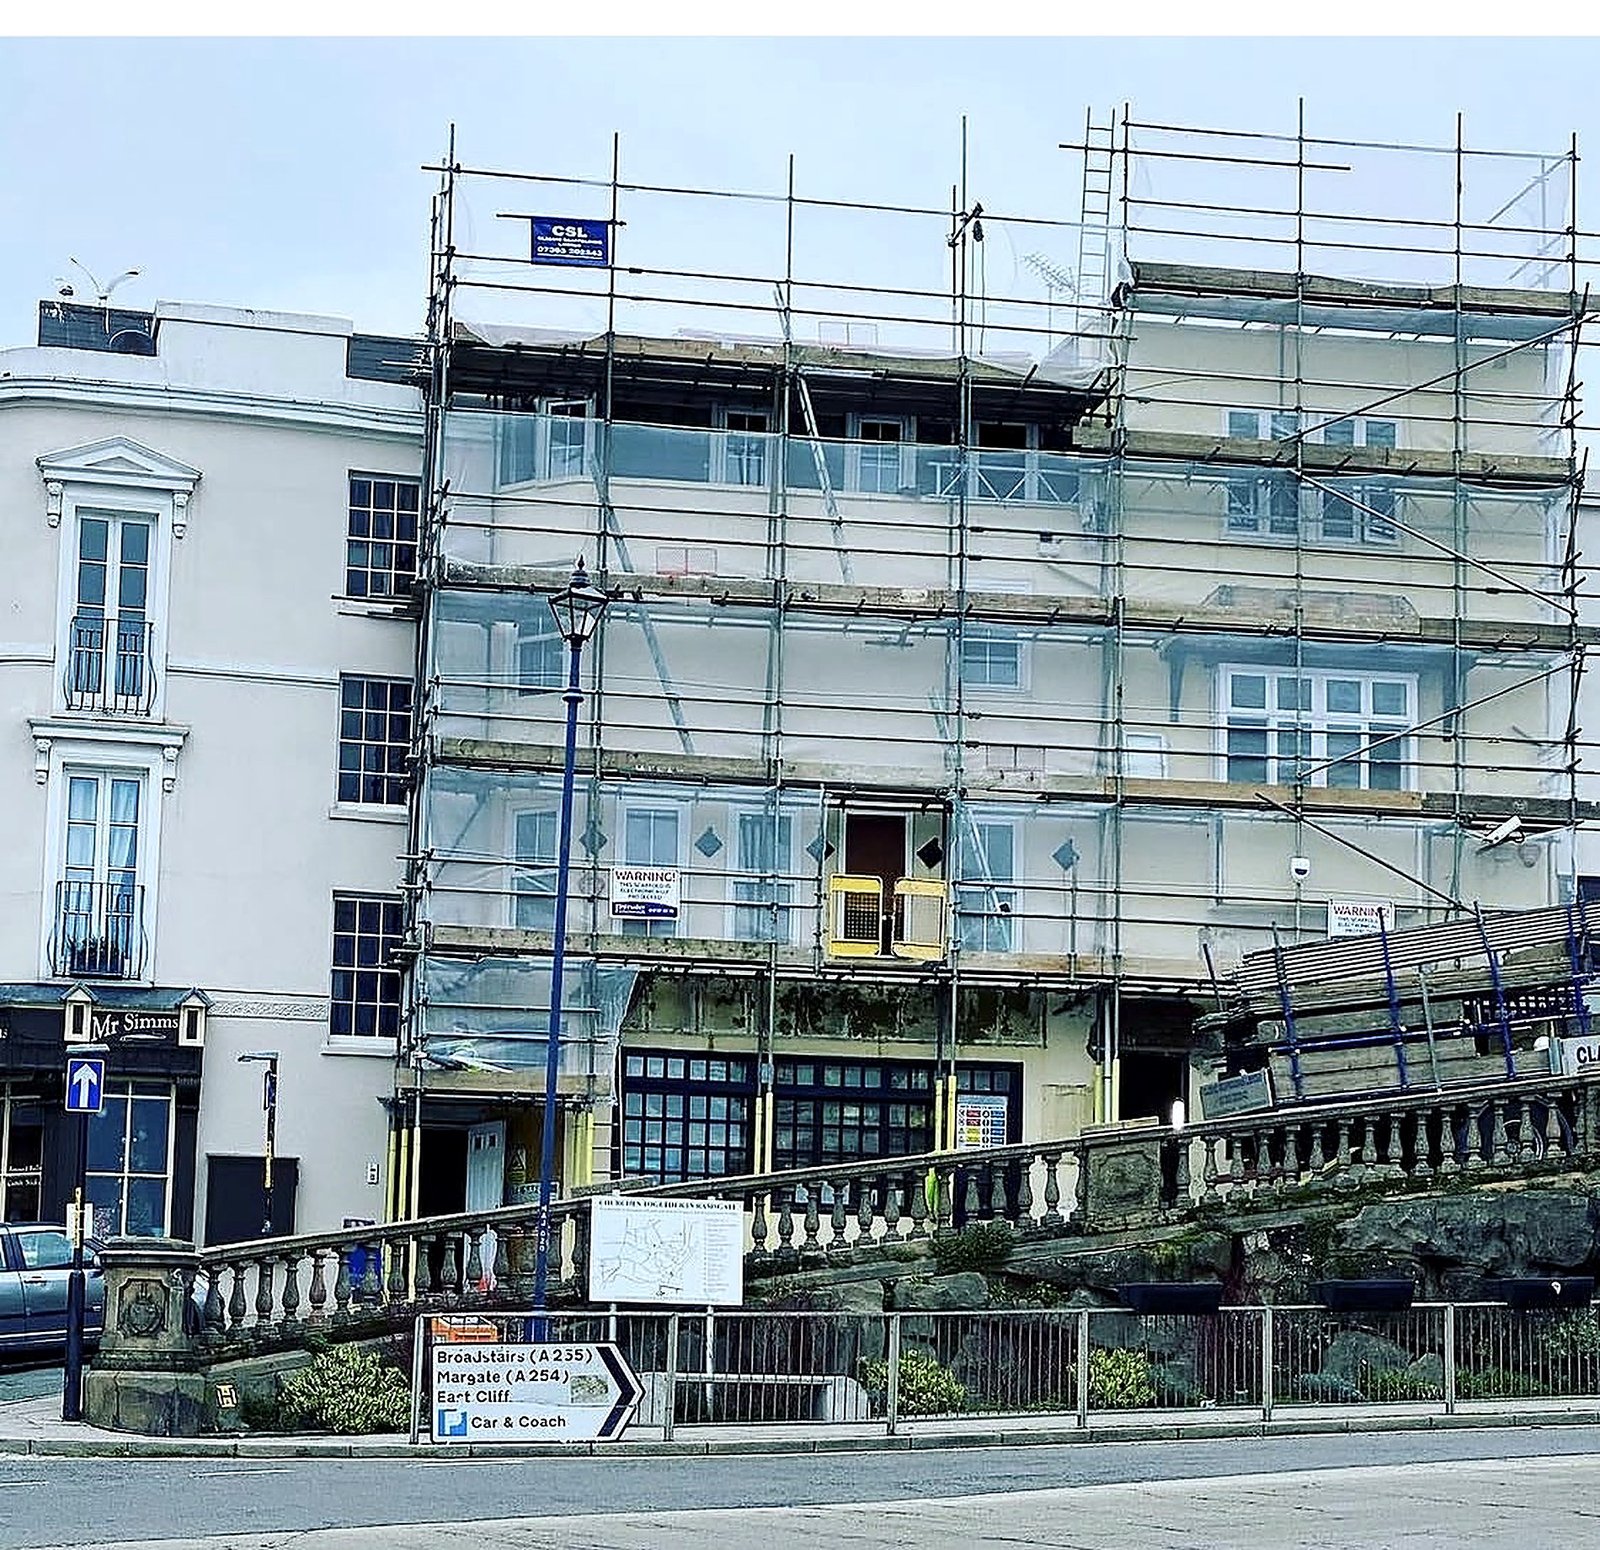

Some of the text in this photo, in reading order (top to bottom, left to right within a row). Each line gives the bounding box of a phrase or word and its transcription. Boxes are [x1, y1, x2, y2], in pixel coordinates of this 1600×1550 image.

[552, 225, 588, 238] CSL
[615, 870, 676, 882] WARNING!
[91, 1013, 178, 1042] Mr Simms
[437, 1350, 525, 1364] Broadstairs
[437, 1370, 501, 1386] Margate
[476, 1390, 510, 1403] Cliff
[471, 1416, 566, 1429] Car & Coach
